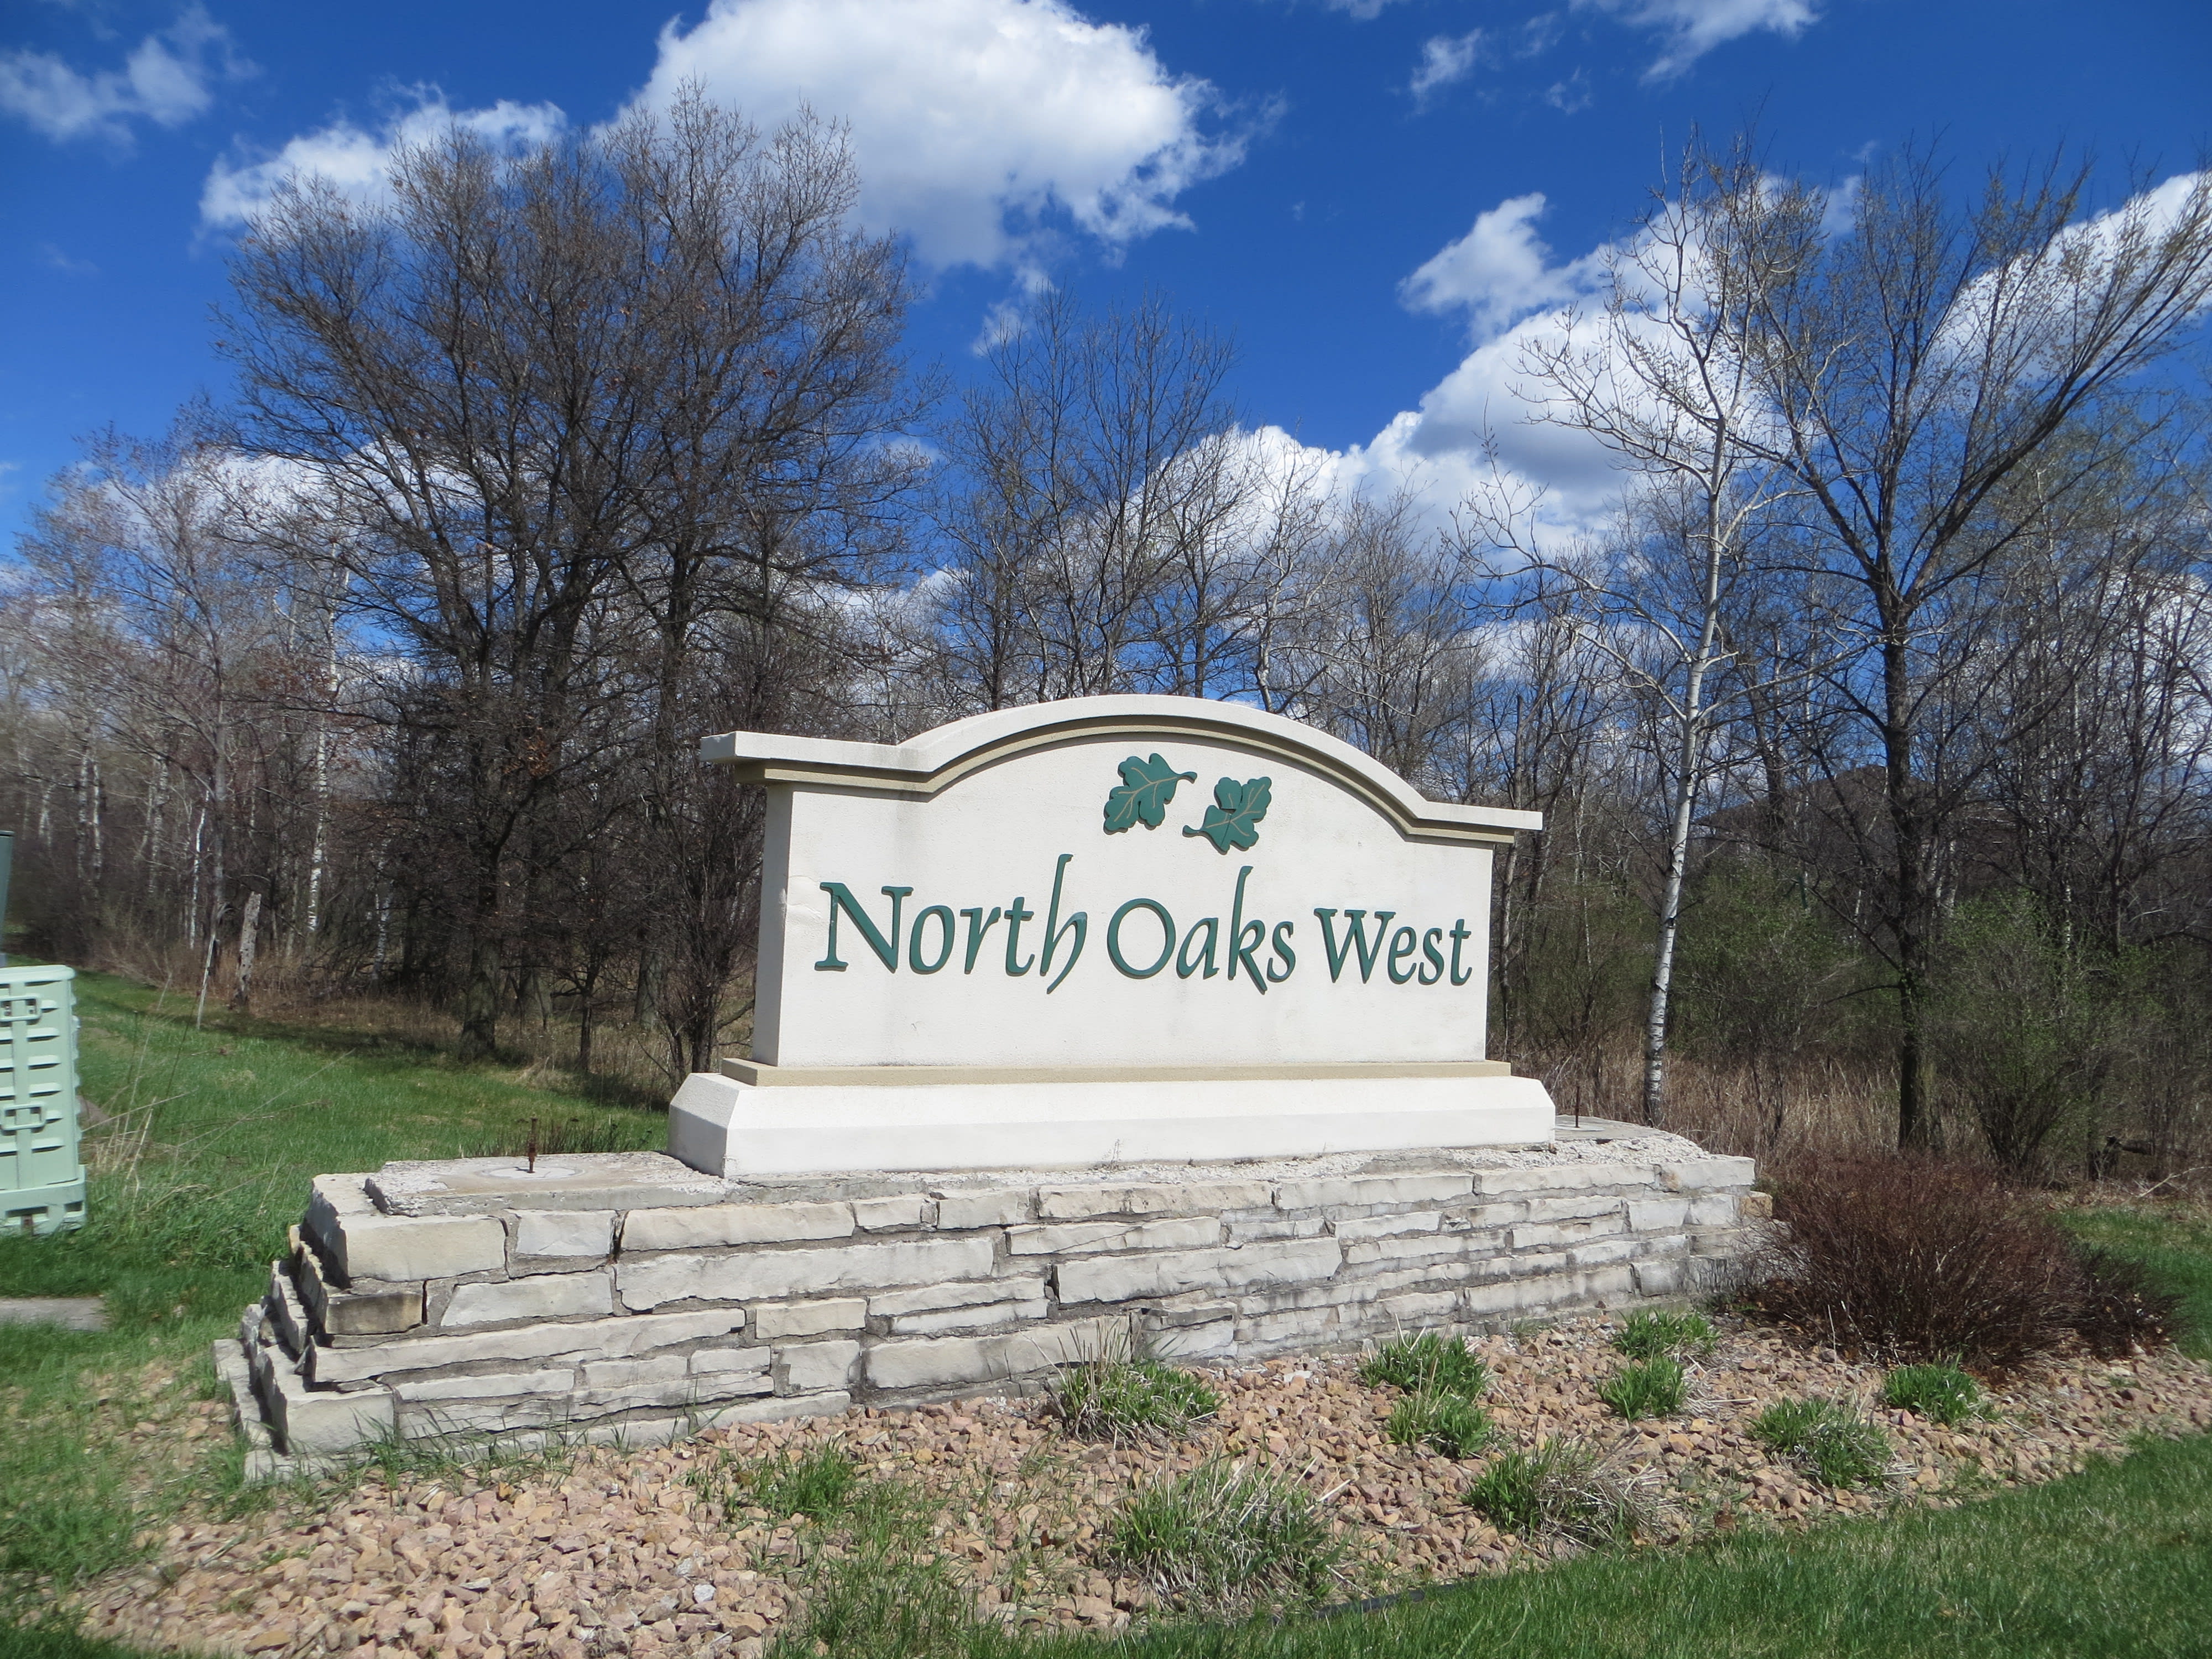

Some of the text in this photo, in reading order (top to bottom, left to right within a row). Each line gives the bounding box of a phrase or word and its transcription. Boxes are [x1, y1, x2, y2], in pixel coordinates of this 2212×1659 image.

[815, 854, 1472, 995] North Oaks West
